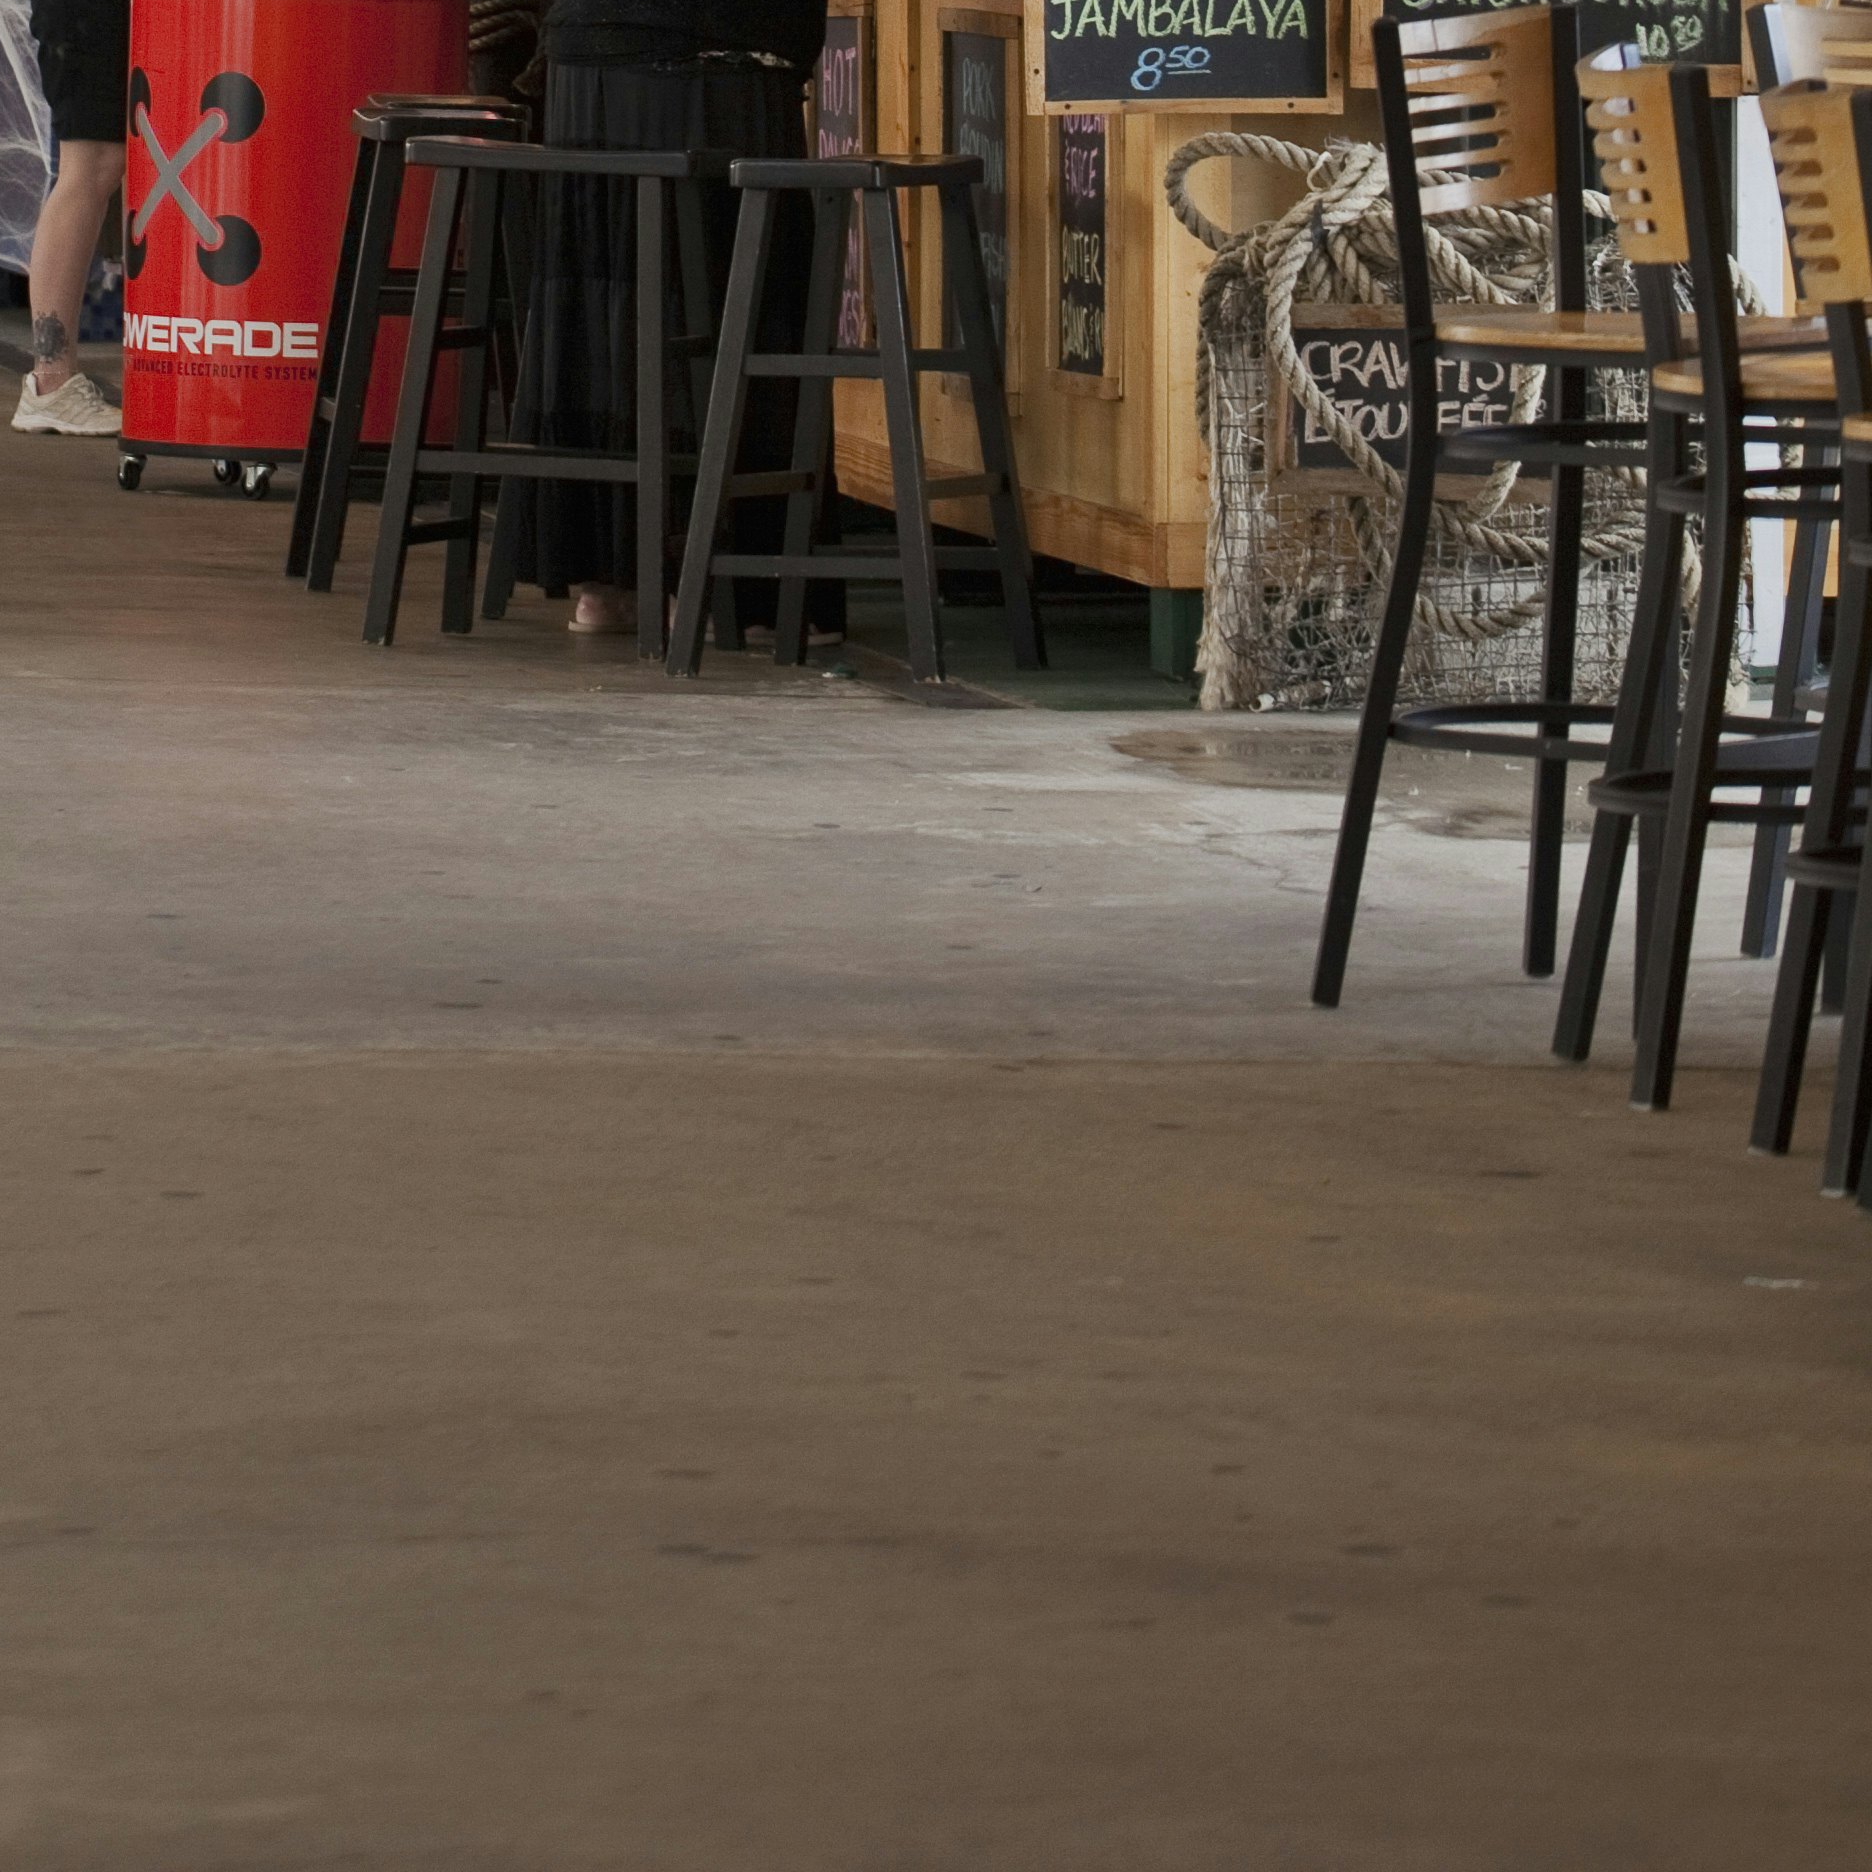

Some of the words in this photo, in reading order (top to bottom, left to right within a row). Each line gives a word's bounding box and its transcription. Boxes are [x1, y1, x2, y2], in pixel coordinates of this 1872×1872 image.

[822, 45, 856, 118] HOT
[961, 56, 997, 122] PORK
[1061, 223, 1103, 286] BUTTER
[176, 361, 260, 381] ELECTROLYTE
